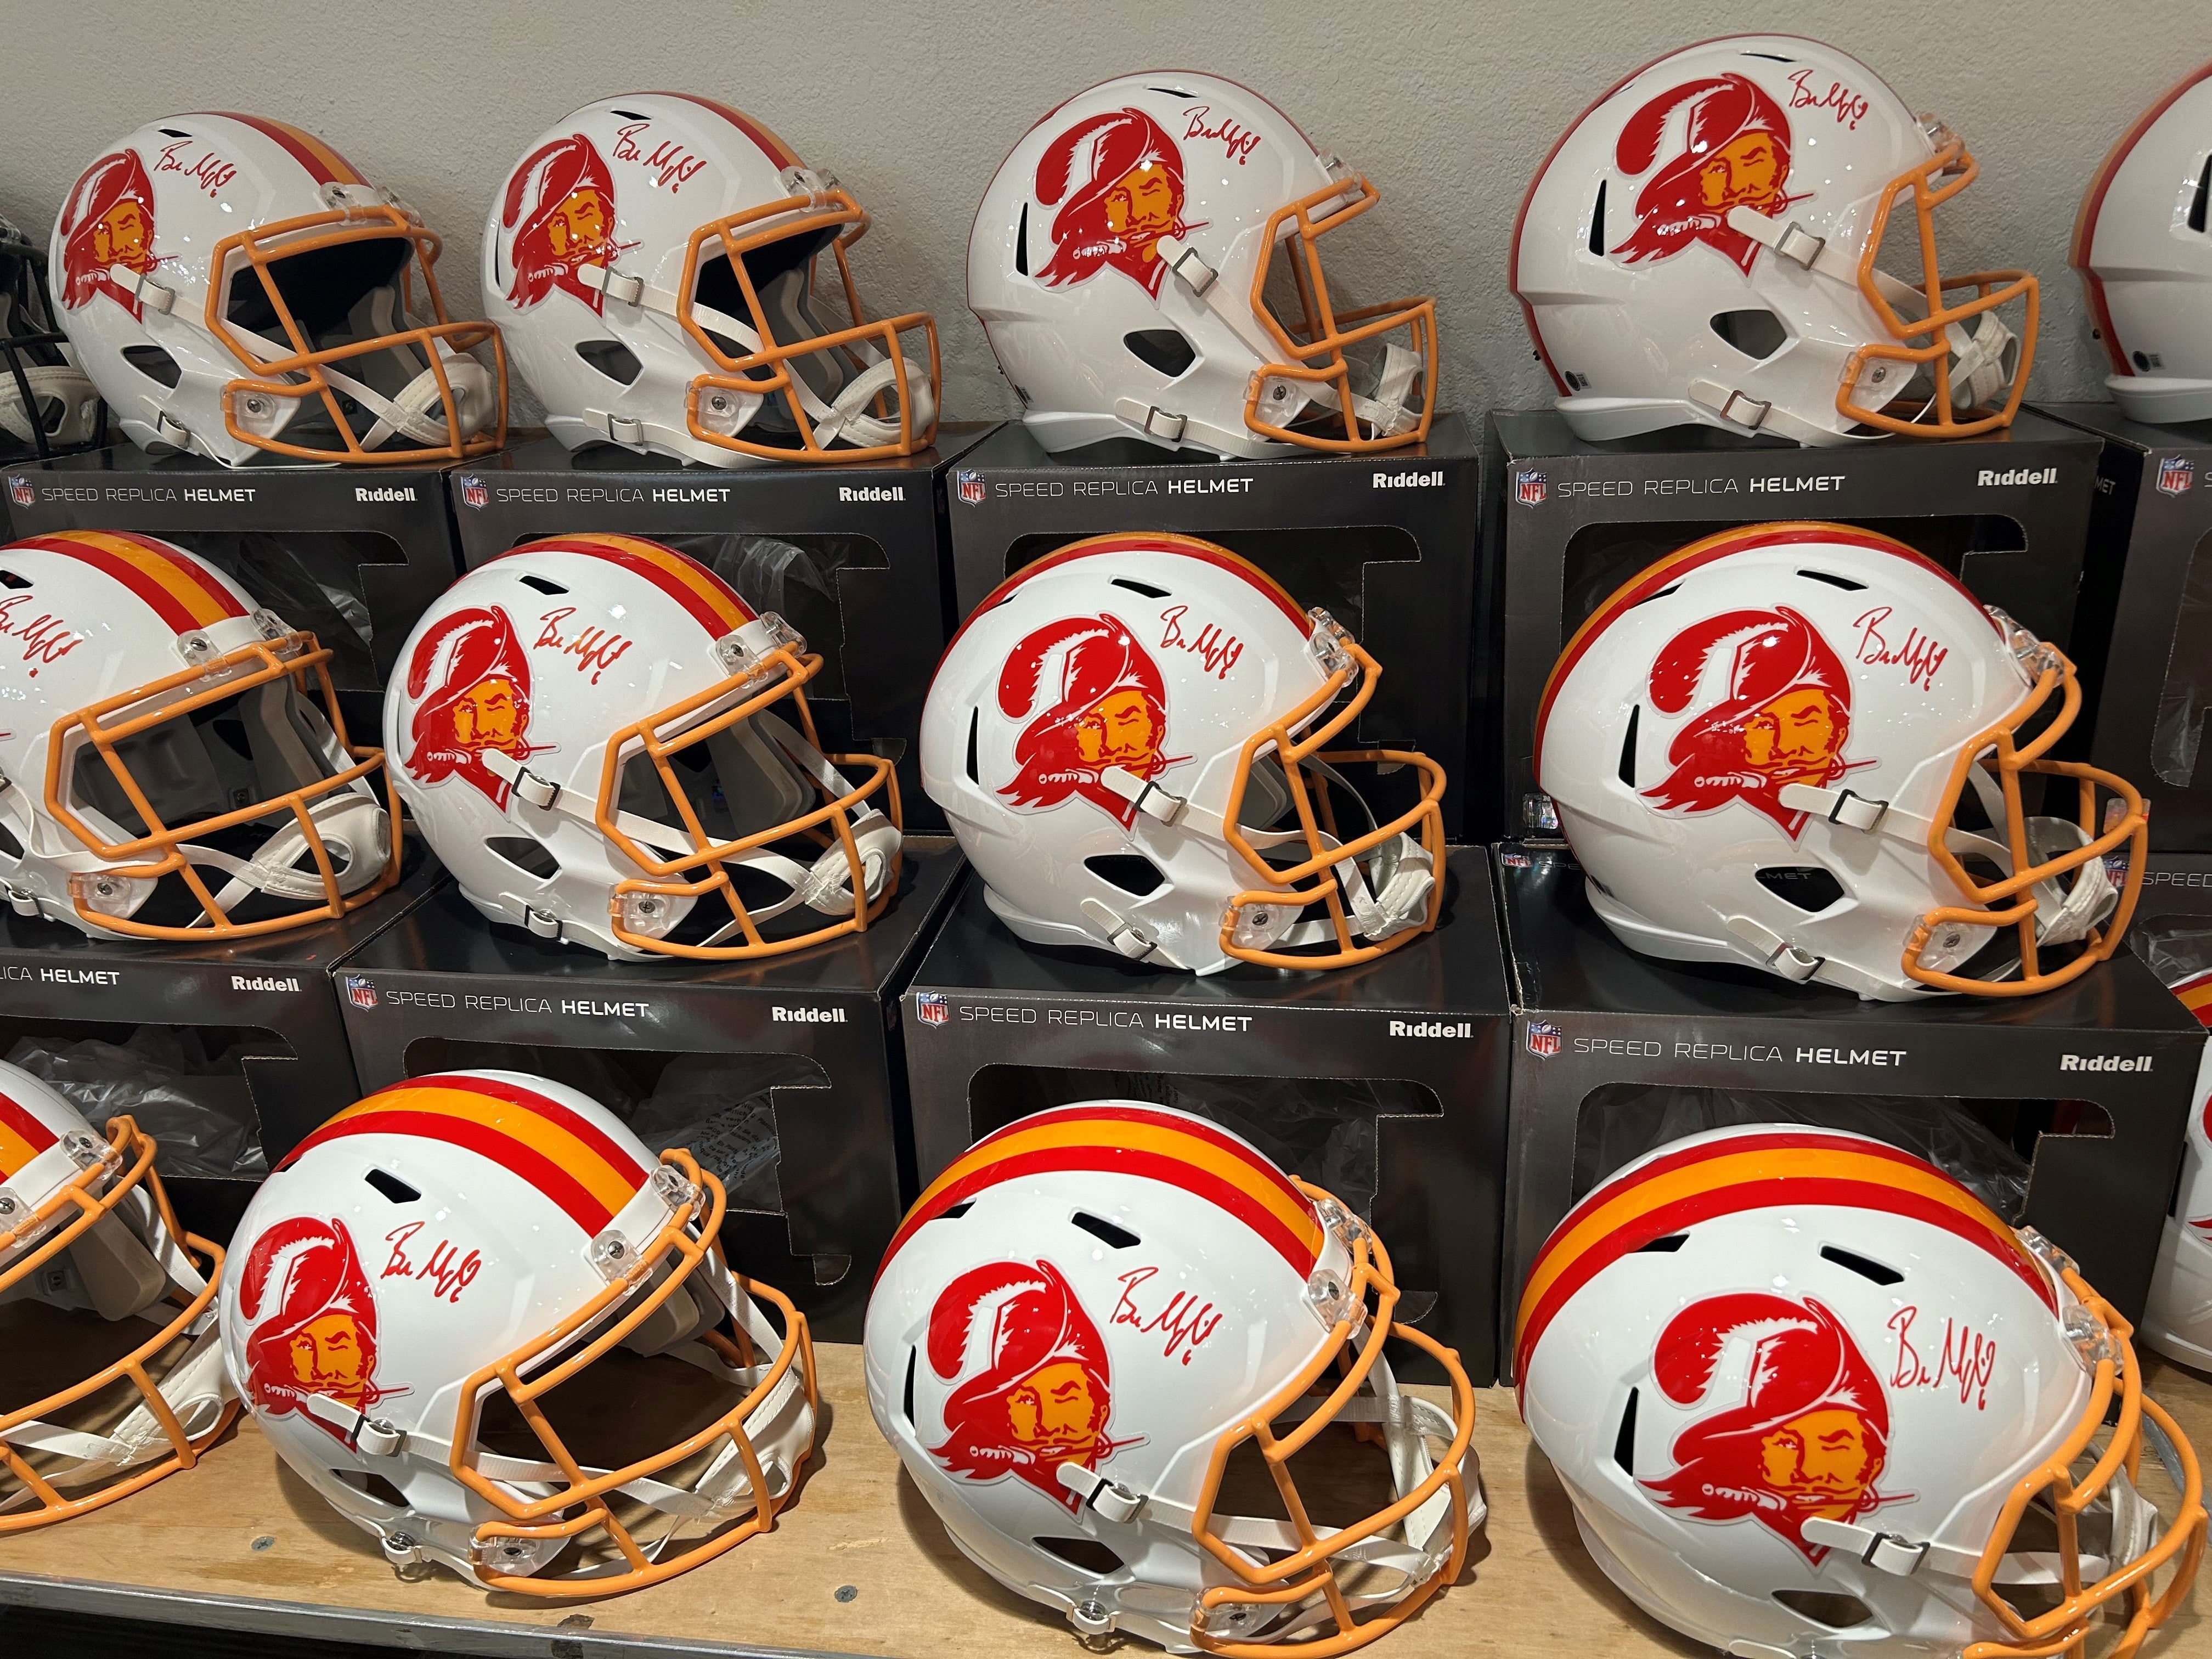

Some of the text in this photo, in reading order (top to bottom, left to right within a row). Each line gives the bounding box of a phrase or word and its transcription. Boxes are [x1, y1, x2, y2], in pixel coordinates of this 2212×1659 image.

[1373, 471, 1445, 488] Riddell
[1978, 468, 2057, 486] Riddell
[2163, 471, 2190, 490] NFL
[42, 488, 256, 501] SPEED REPLICA HELMET
[356, 488, 417, 501] Riddell
[497, 489, 730, 501] SPEED REPLICA HELMET
[839, 487, 903, 501] Riddell
[962, 483, 986, 502] NFL
[996, 478, 1253, 496] SPEED REPLICA HELMET
[1521, 483, 1547, 503] NFL
[1558, 476, 1845, 497] SPEED REPLICA HELMET
[14, 488, 35, 503] NFL
[466, 488, 489, 504] NFL
[41, 968, 120, 985] HELMET
[232, 976, 301, 991] Riddell
[353, 989, 378, 1006] NFL
[386, 991, 650, 1017] SPEED REPLICA HELMET
[772, 1007, 848, 1022] Riddell
[922, 1004, 949, 1022] NFL
[960, 1007, 1252, 1031] SPEED REPLICA HELMET
[1390, 1021, 1473, 1037] Riddell
[1532, 1034, 1561, 1054] NFL
[1575, 1039, 1906, 1066] SPEED REPLICA HELMET
[2060, 1055, 2153, 1071] Riddell
